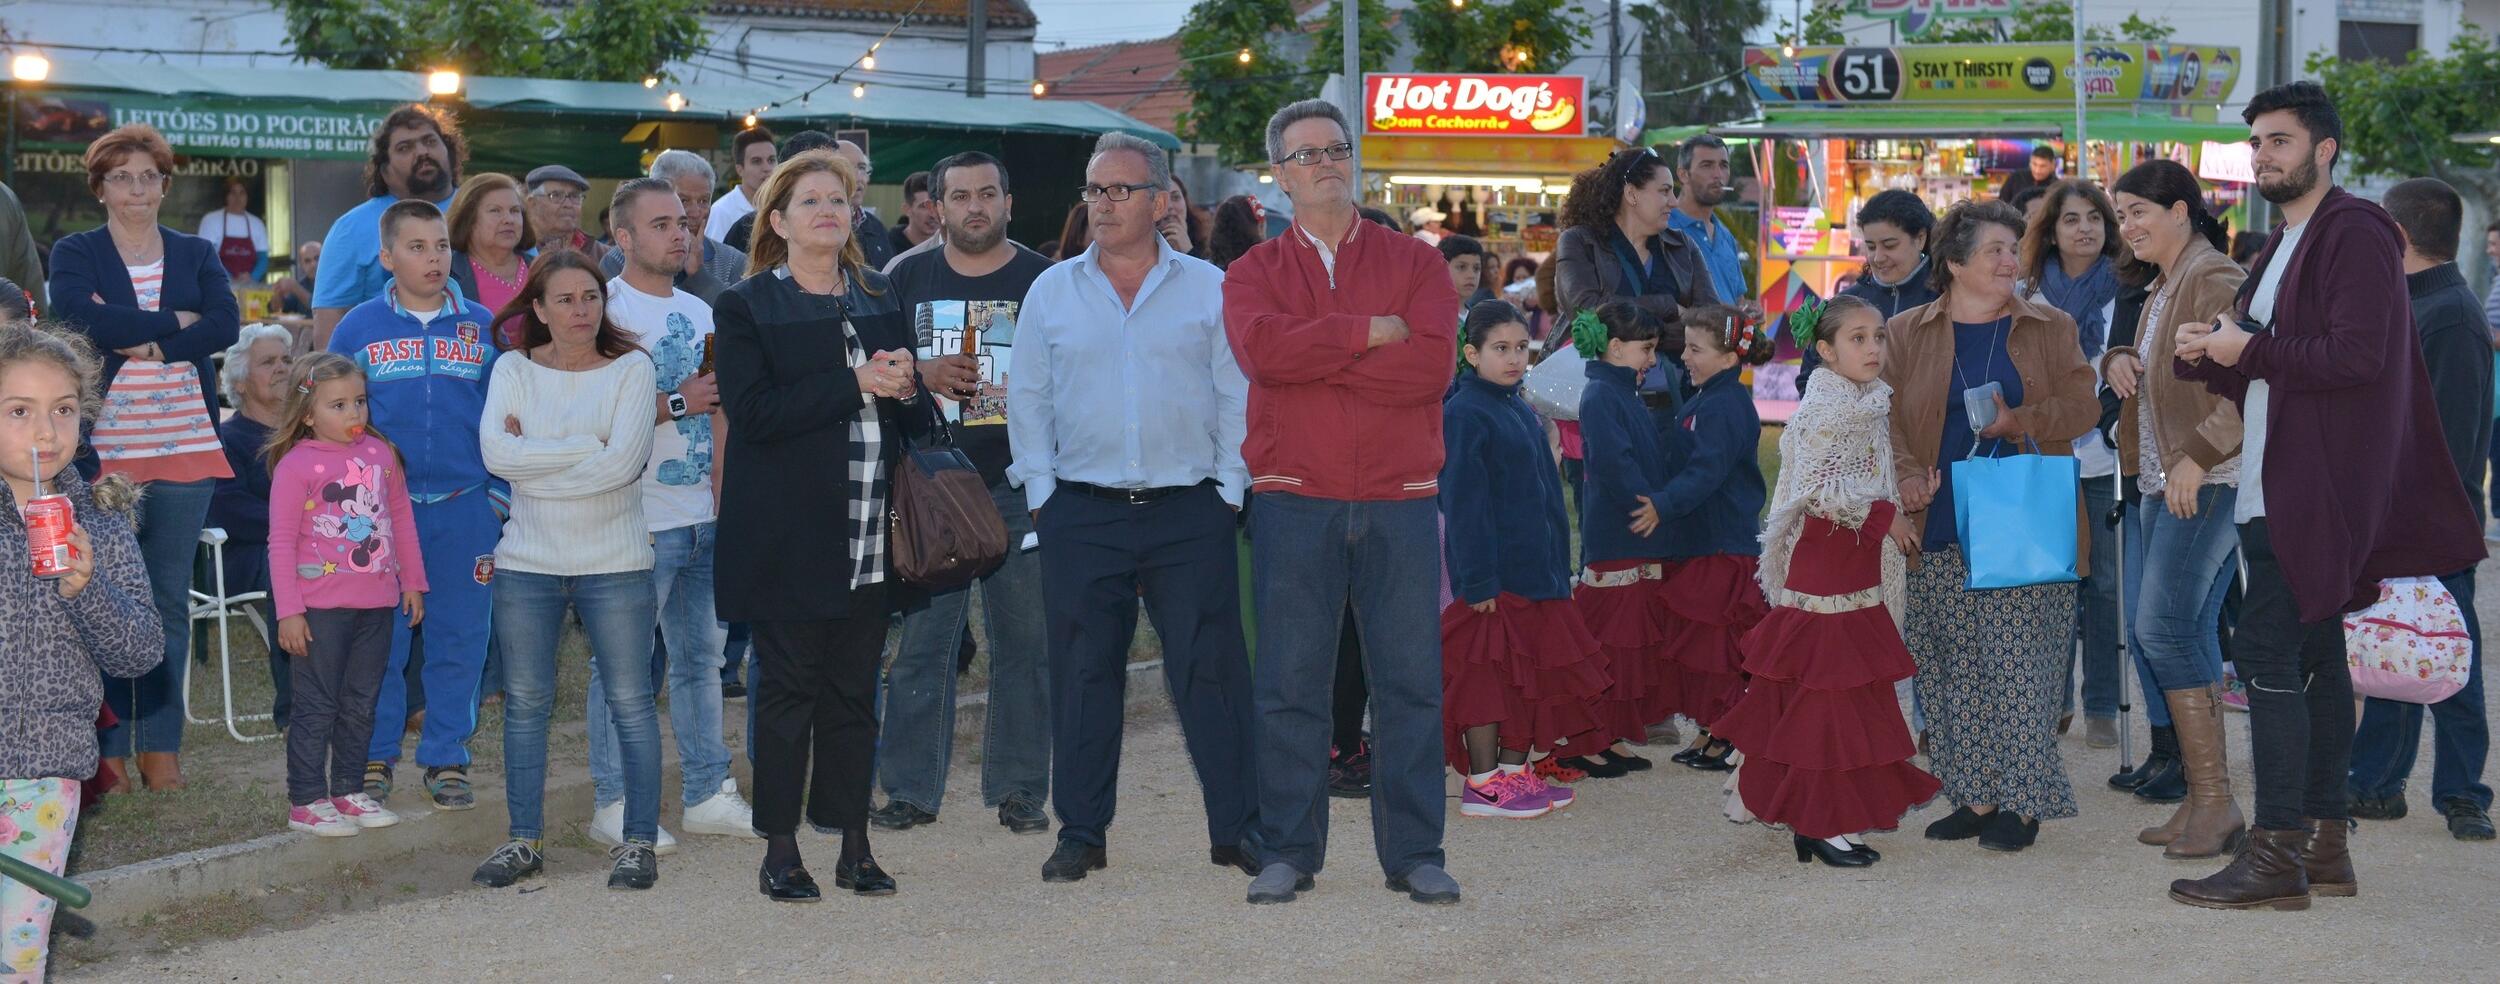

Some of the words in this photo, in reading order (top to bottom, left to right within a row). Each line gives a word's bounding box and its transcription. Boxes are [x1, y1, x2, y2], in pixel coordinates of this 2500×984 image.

[1844, 54, 1891, 95] 51
[1913, 62, 1949, 78] STAY
[1954, 61, 2014, 78] THIRSTY
[1374, 78, 1452, 116] Hot
[224, 114, 259, 134] DO
[166, 132, 186, 146] DE
[189, 132, 240, 148] LEITÃO
[243, 135, 253, 148] E
[256, 136, 312, 150] SANDES
[315, 138, 333, 151] DE
[337, 138, 369, 153] LEIT
[367, 338, 425, 365] FAST
[434, 338, 484, 365] BALL
